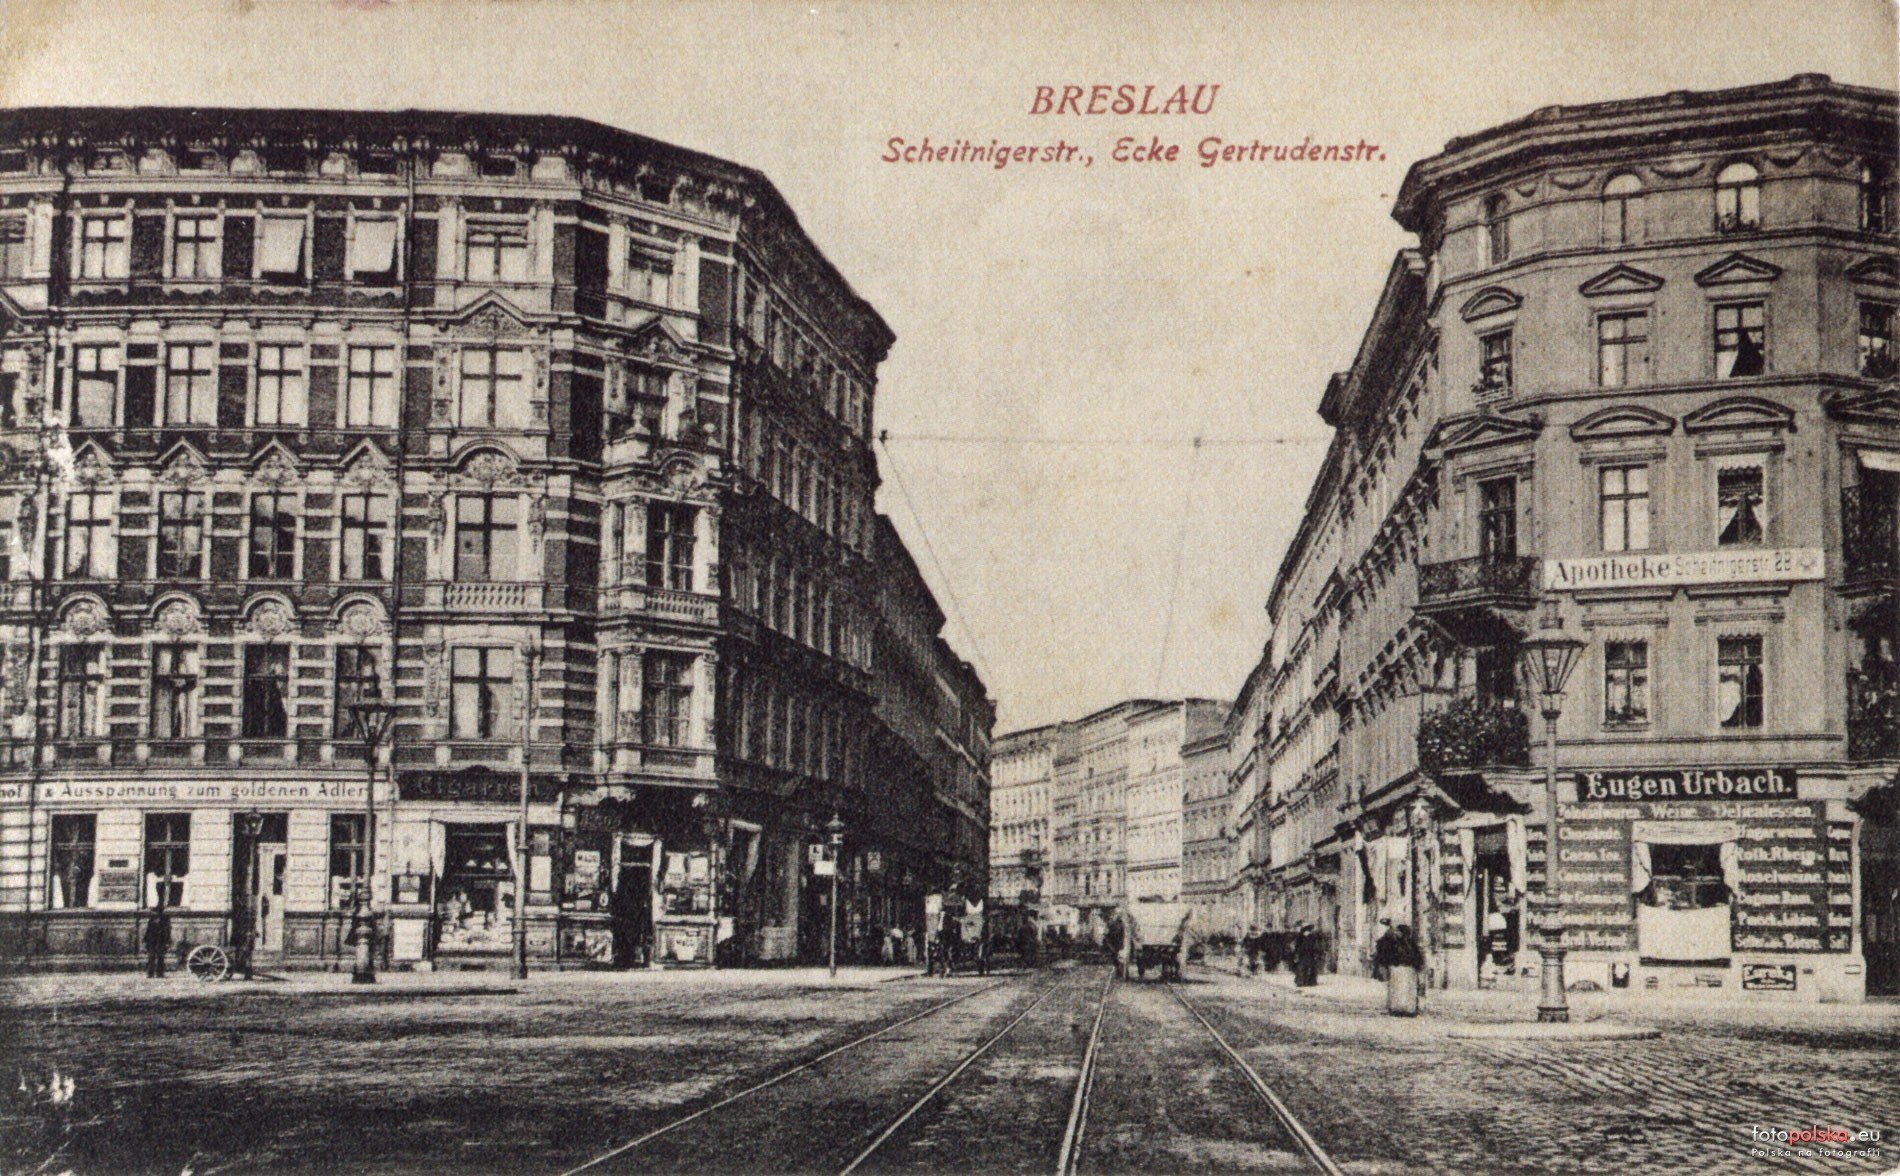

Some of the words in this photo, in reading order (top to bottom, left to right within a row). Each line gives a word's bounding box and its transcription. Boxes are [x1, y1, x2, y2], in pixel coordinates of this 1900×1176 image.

[1556, 557, 1670, 585] Apotheke
[61, 783, 177, 800] Ausspannung
[187, 784, 221, 797] zum
[231, 781, 309, 800] goldenen
[1586, 772, 1678, 799] Eugen
[1681, 770, 1792, 796] Urbach.
